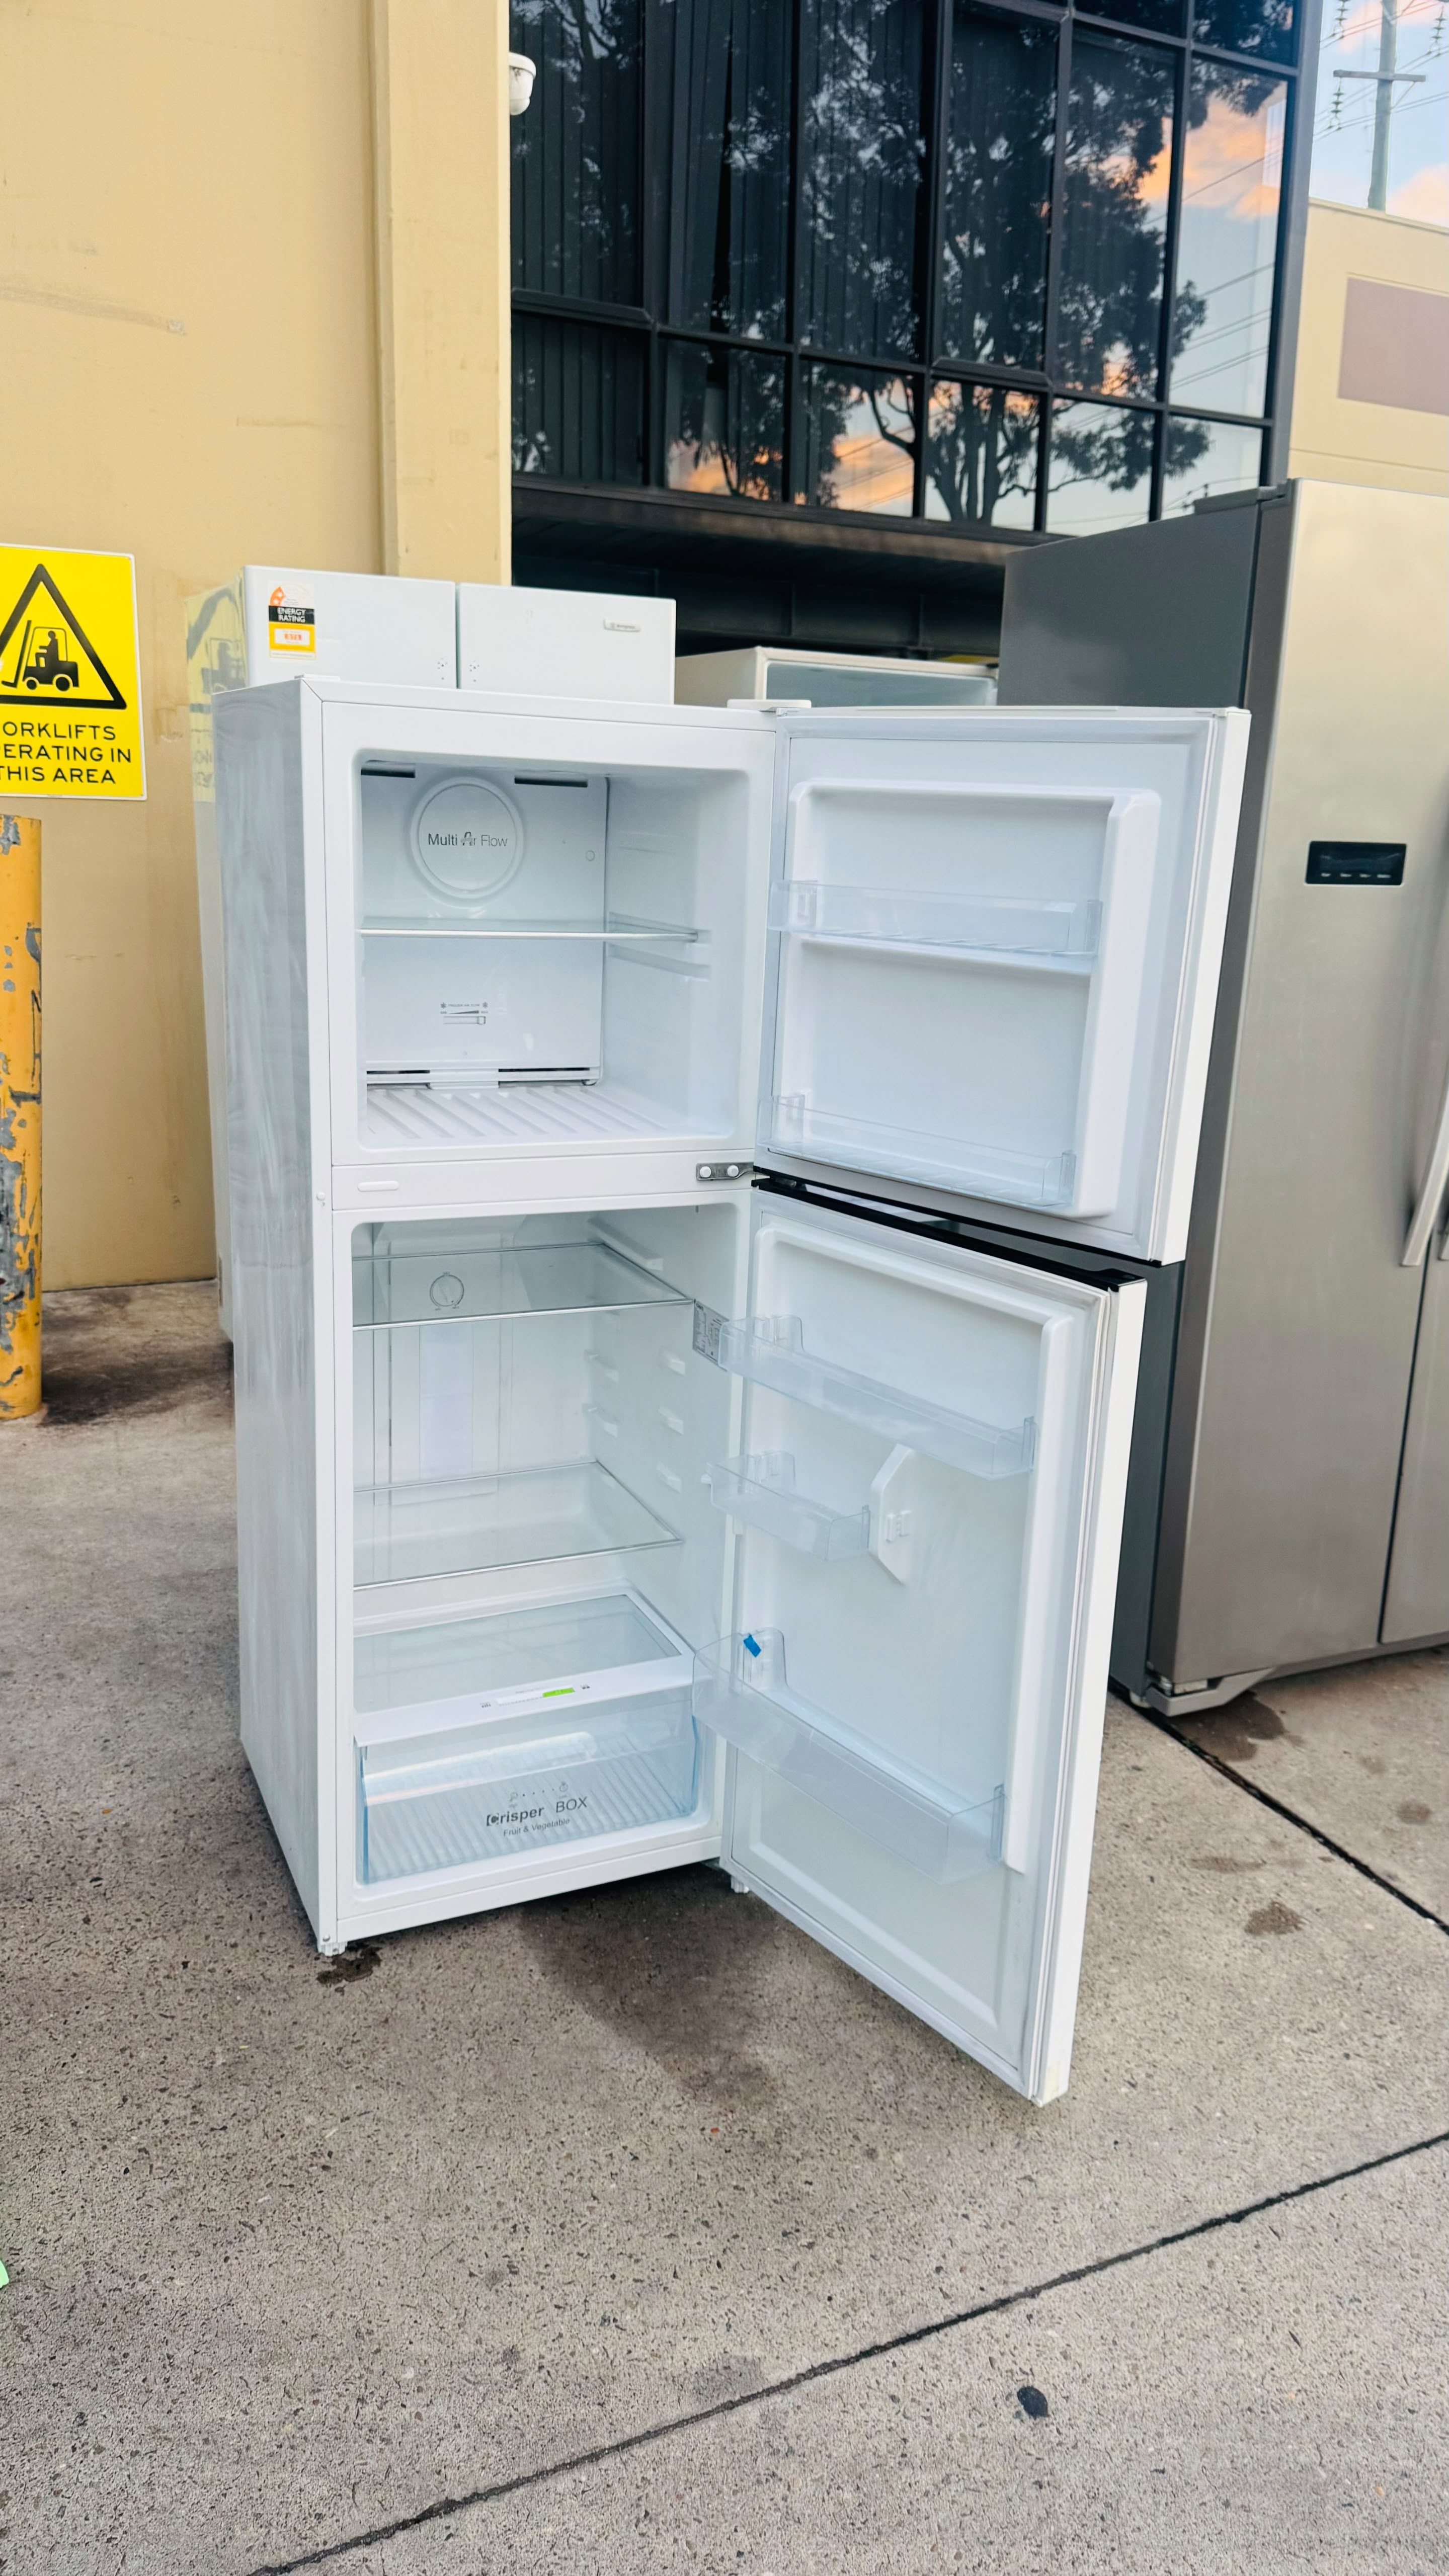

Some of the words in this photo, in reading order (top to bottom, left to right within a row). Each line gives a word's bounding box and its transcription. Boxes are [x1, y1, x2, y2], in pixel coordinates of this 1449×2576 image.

[277, 607, 306, 615] ENERGY
[278, 615, 306, 623] RATING
[3, 721, 116, 741] ORKLIFTS
[0, 744, 103, 762] ERATING
[111, 748, 131, 763] IN
[52, 768, 116, 784] AREA
[428, 833, 458, 846] Multi
[481, 834, 508, 847] Flow
[555, 1796, 588, 1813] BOX
[503, 1827, 521, 1836] Fruit
[531, 1818, 570, 1831] Vegetable
